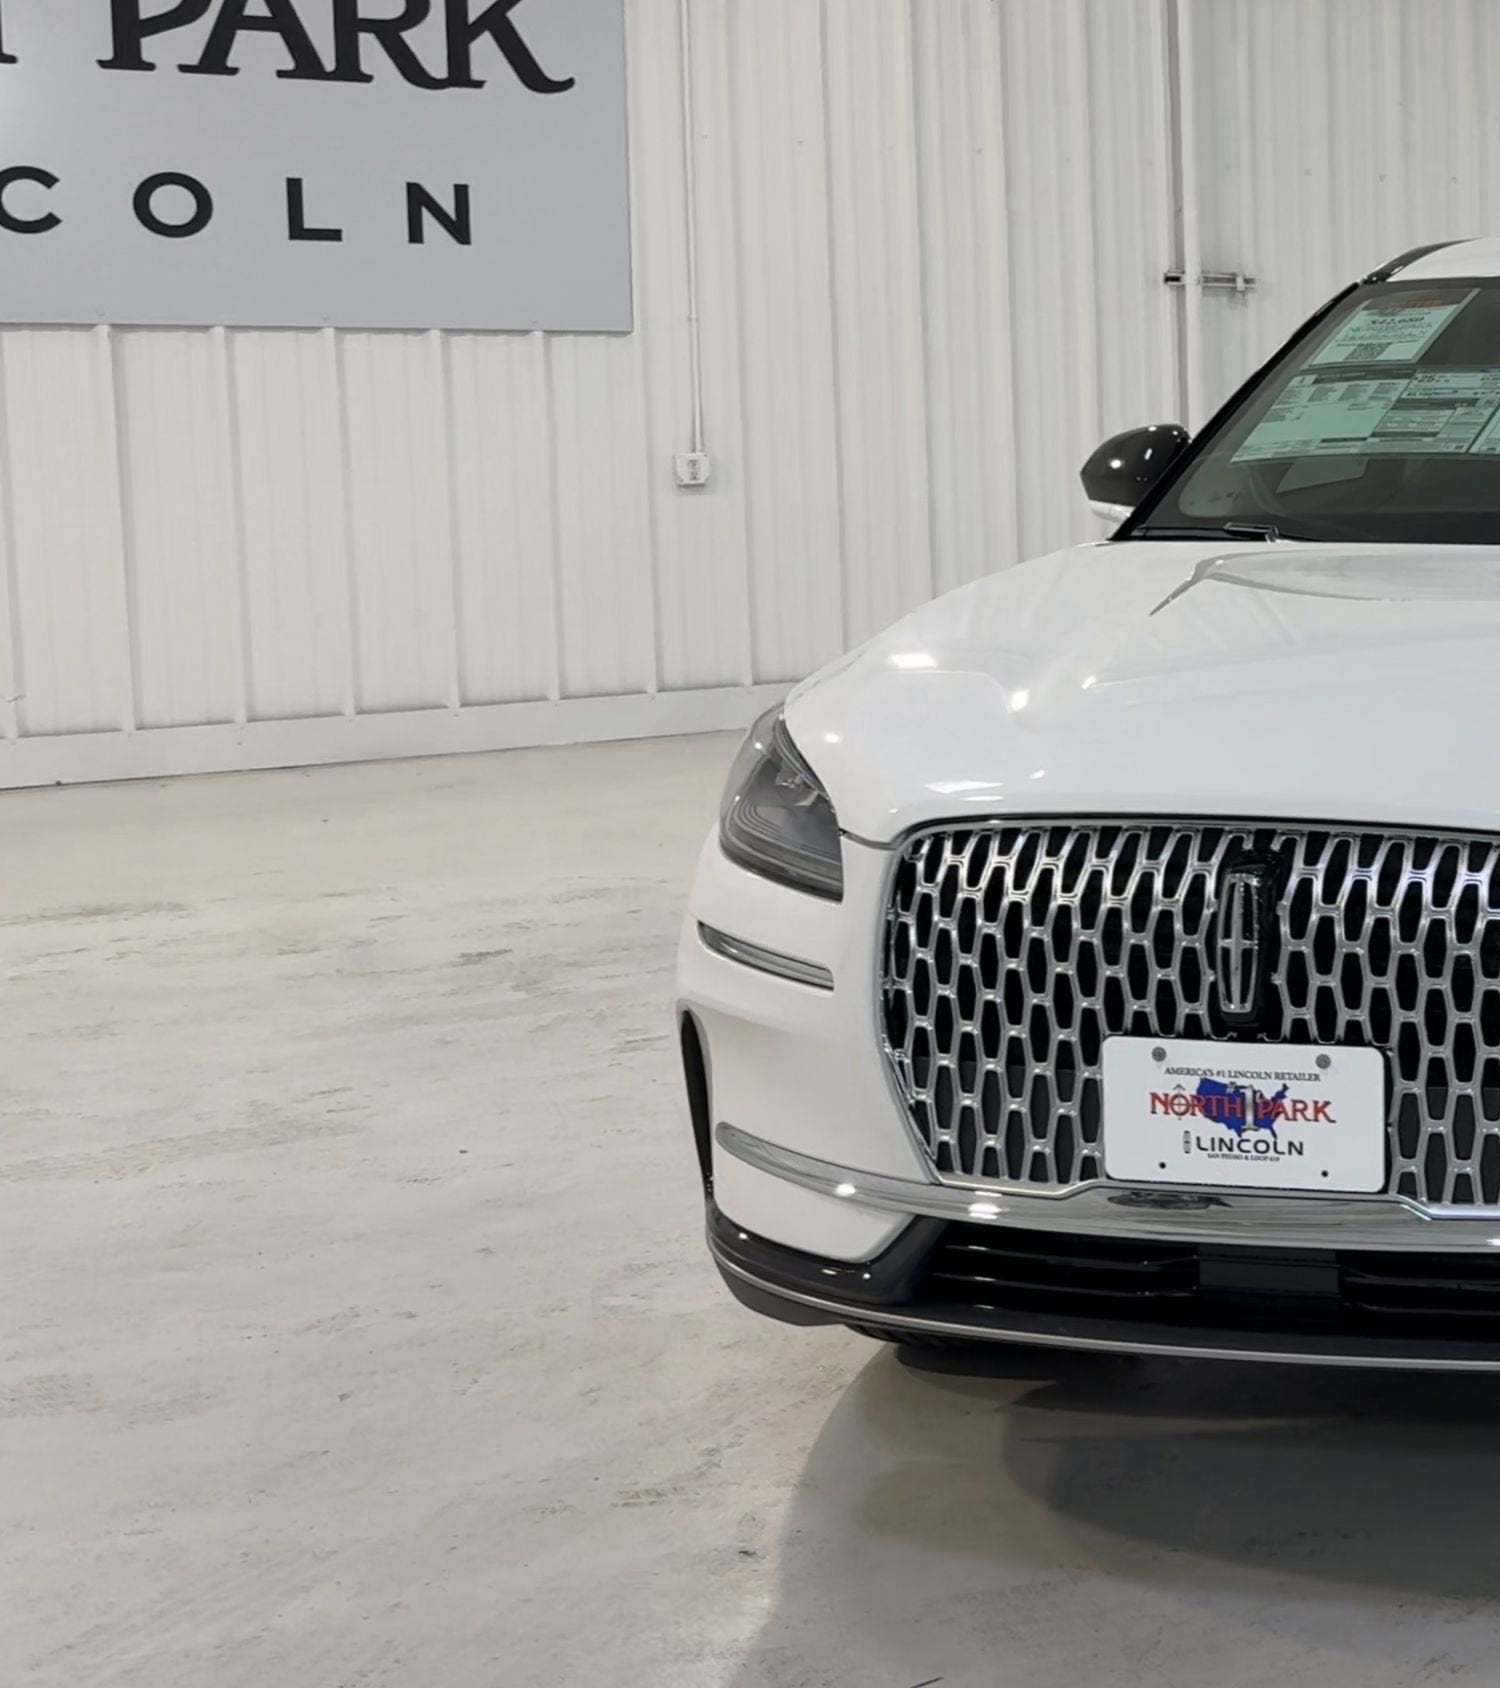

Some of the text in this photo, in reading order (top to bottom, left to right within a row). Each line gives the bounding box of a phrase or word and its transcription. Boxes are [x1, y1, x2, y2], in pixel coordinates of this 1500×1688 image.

[97, 0, 575, 94] PARK
[0, 166, 472, 245] COLN
[1165, 1067, 1214, 1077] AMERICA'S
[1228, 1070, 1272, 1079] LINCOLN
[1275, 1072, 1321, 1082] RETAILER
[1150, 1092, 1336, 1123] NORTH PARK
[1196, 1136, 1304, 1156] LINCOLN
